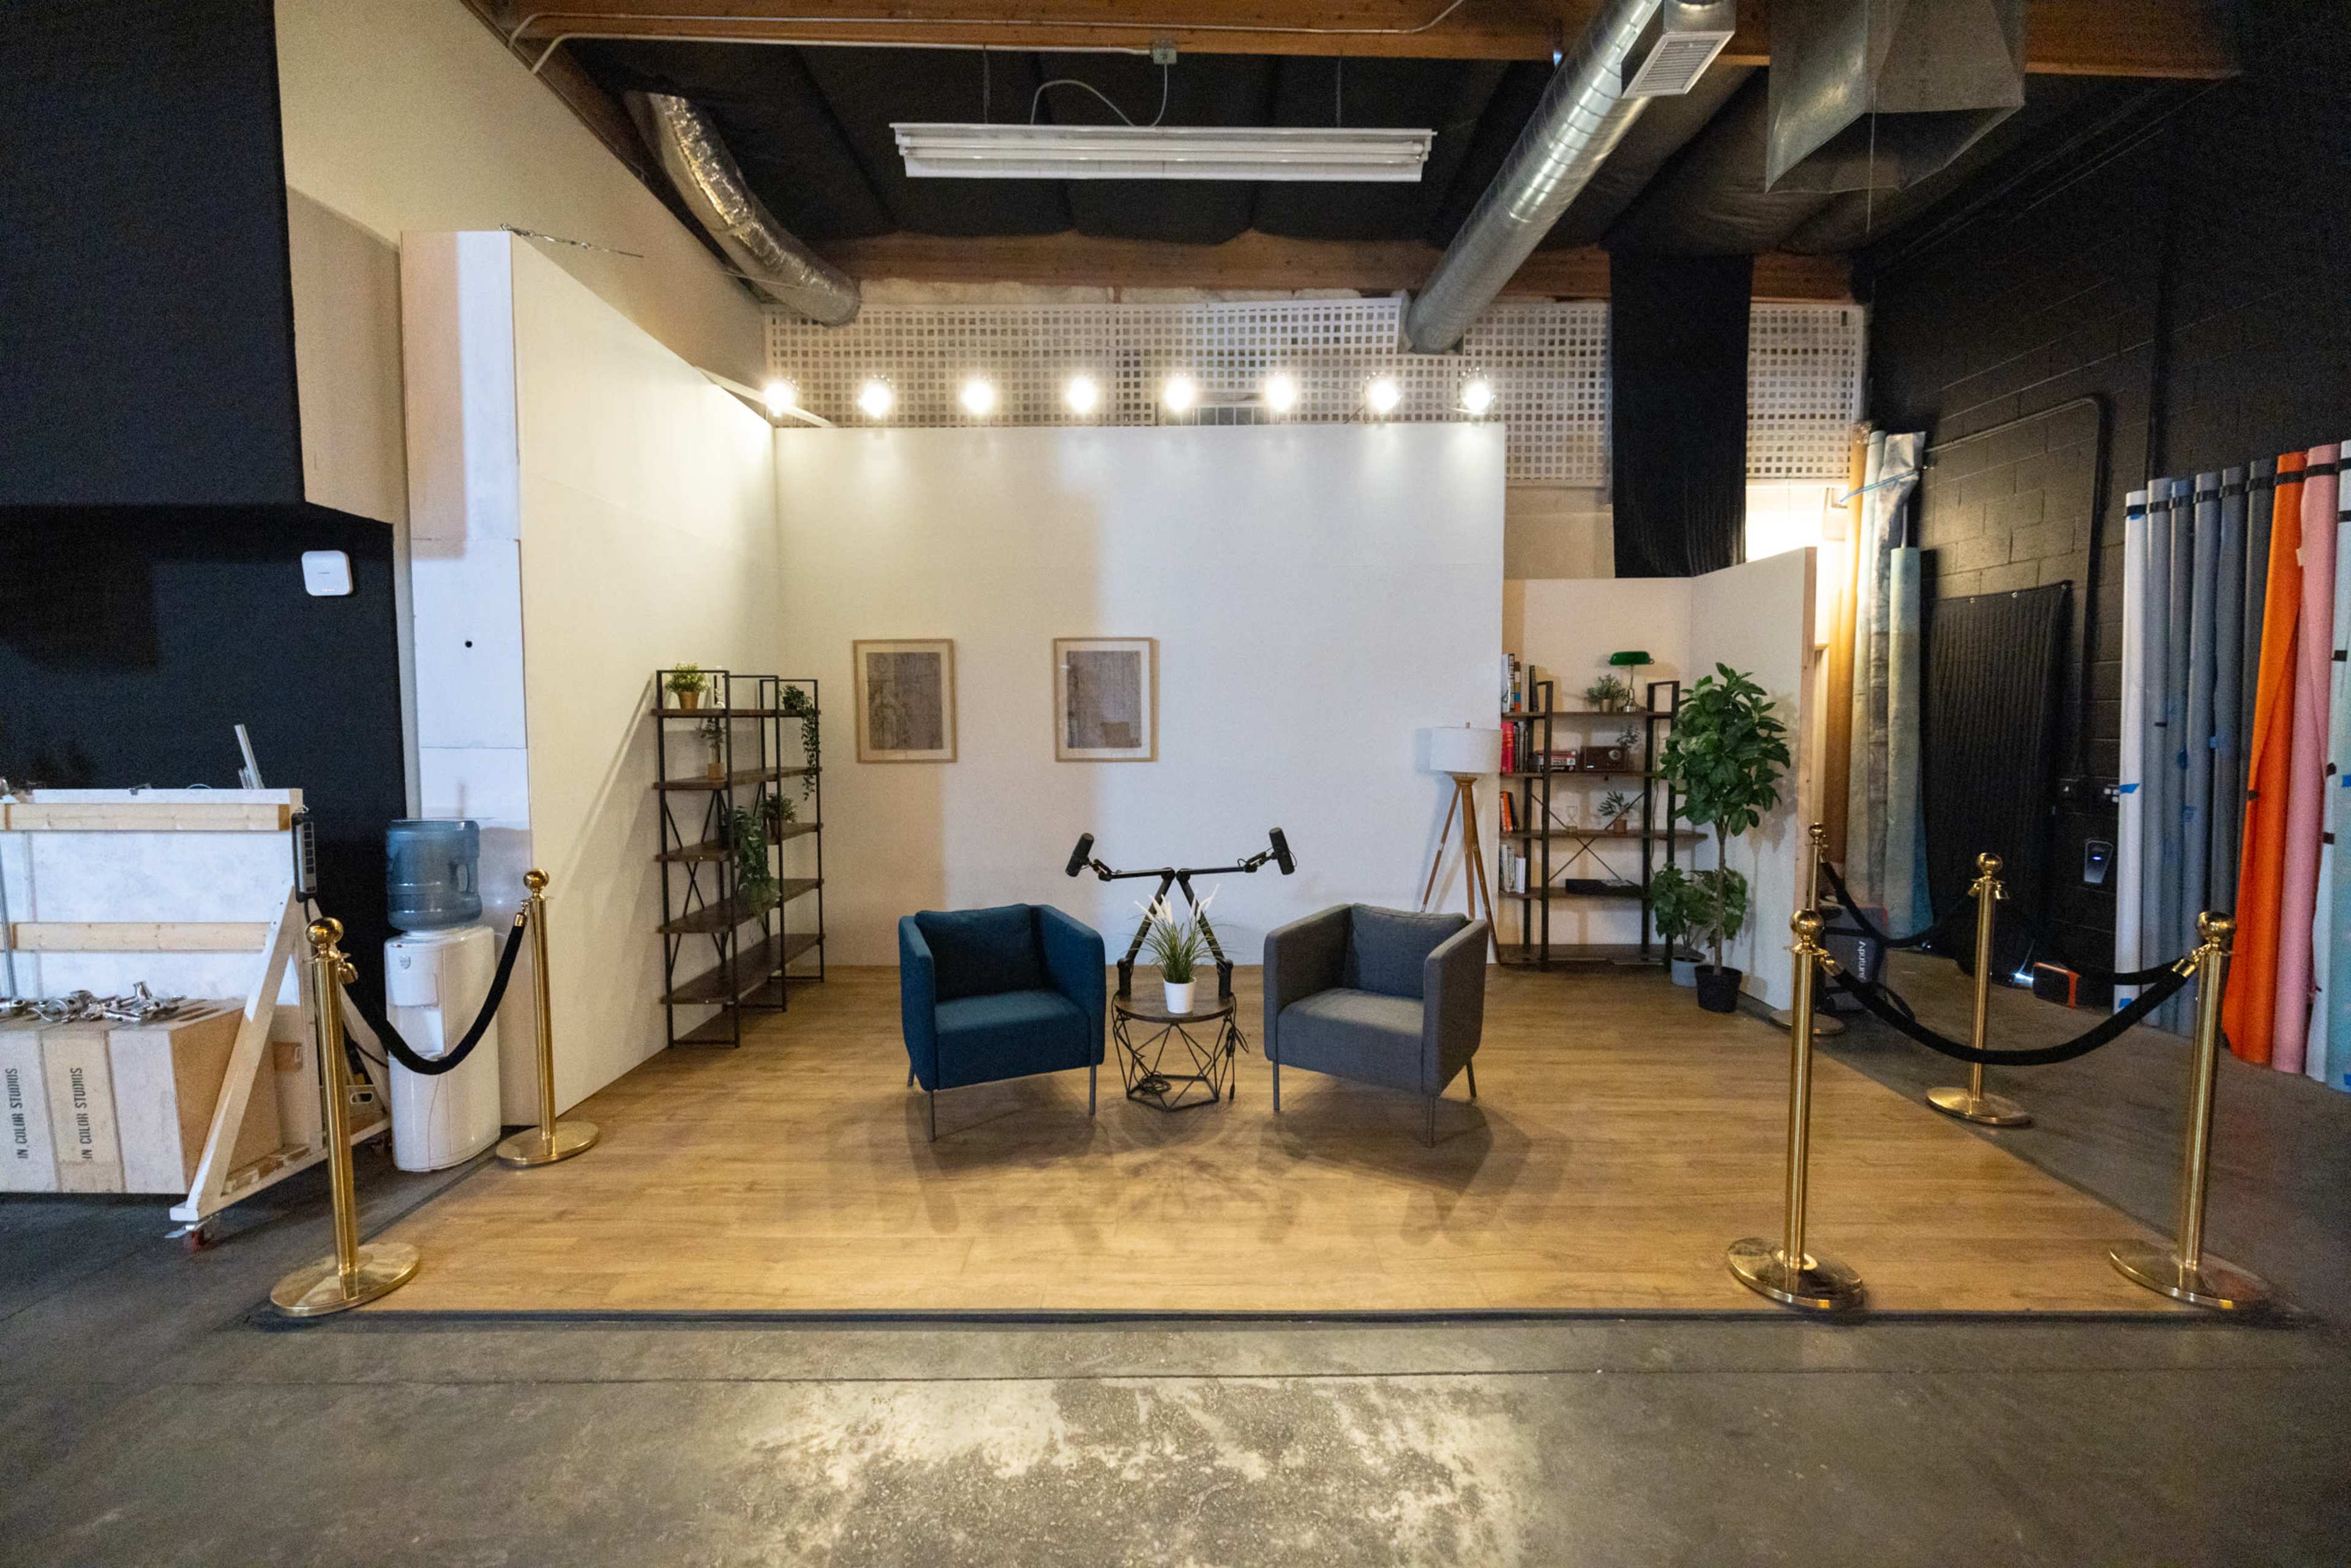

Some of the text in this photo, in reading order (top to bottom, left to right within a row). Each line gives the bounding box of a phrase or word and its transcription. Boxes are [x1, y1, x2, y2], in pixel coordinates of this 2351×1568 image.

[1857, 940, 1867, 978] Aputure
[5, 1068, 29, 1159] IN COLOR STUDIOS
[70, 1067, 93, 1159] IN COLOR STUDIOS
